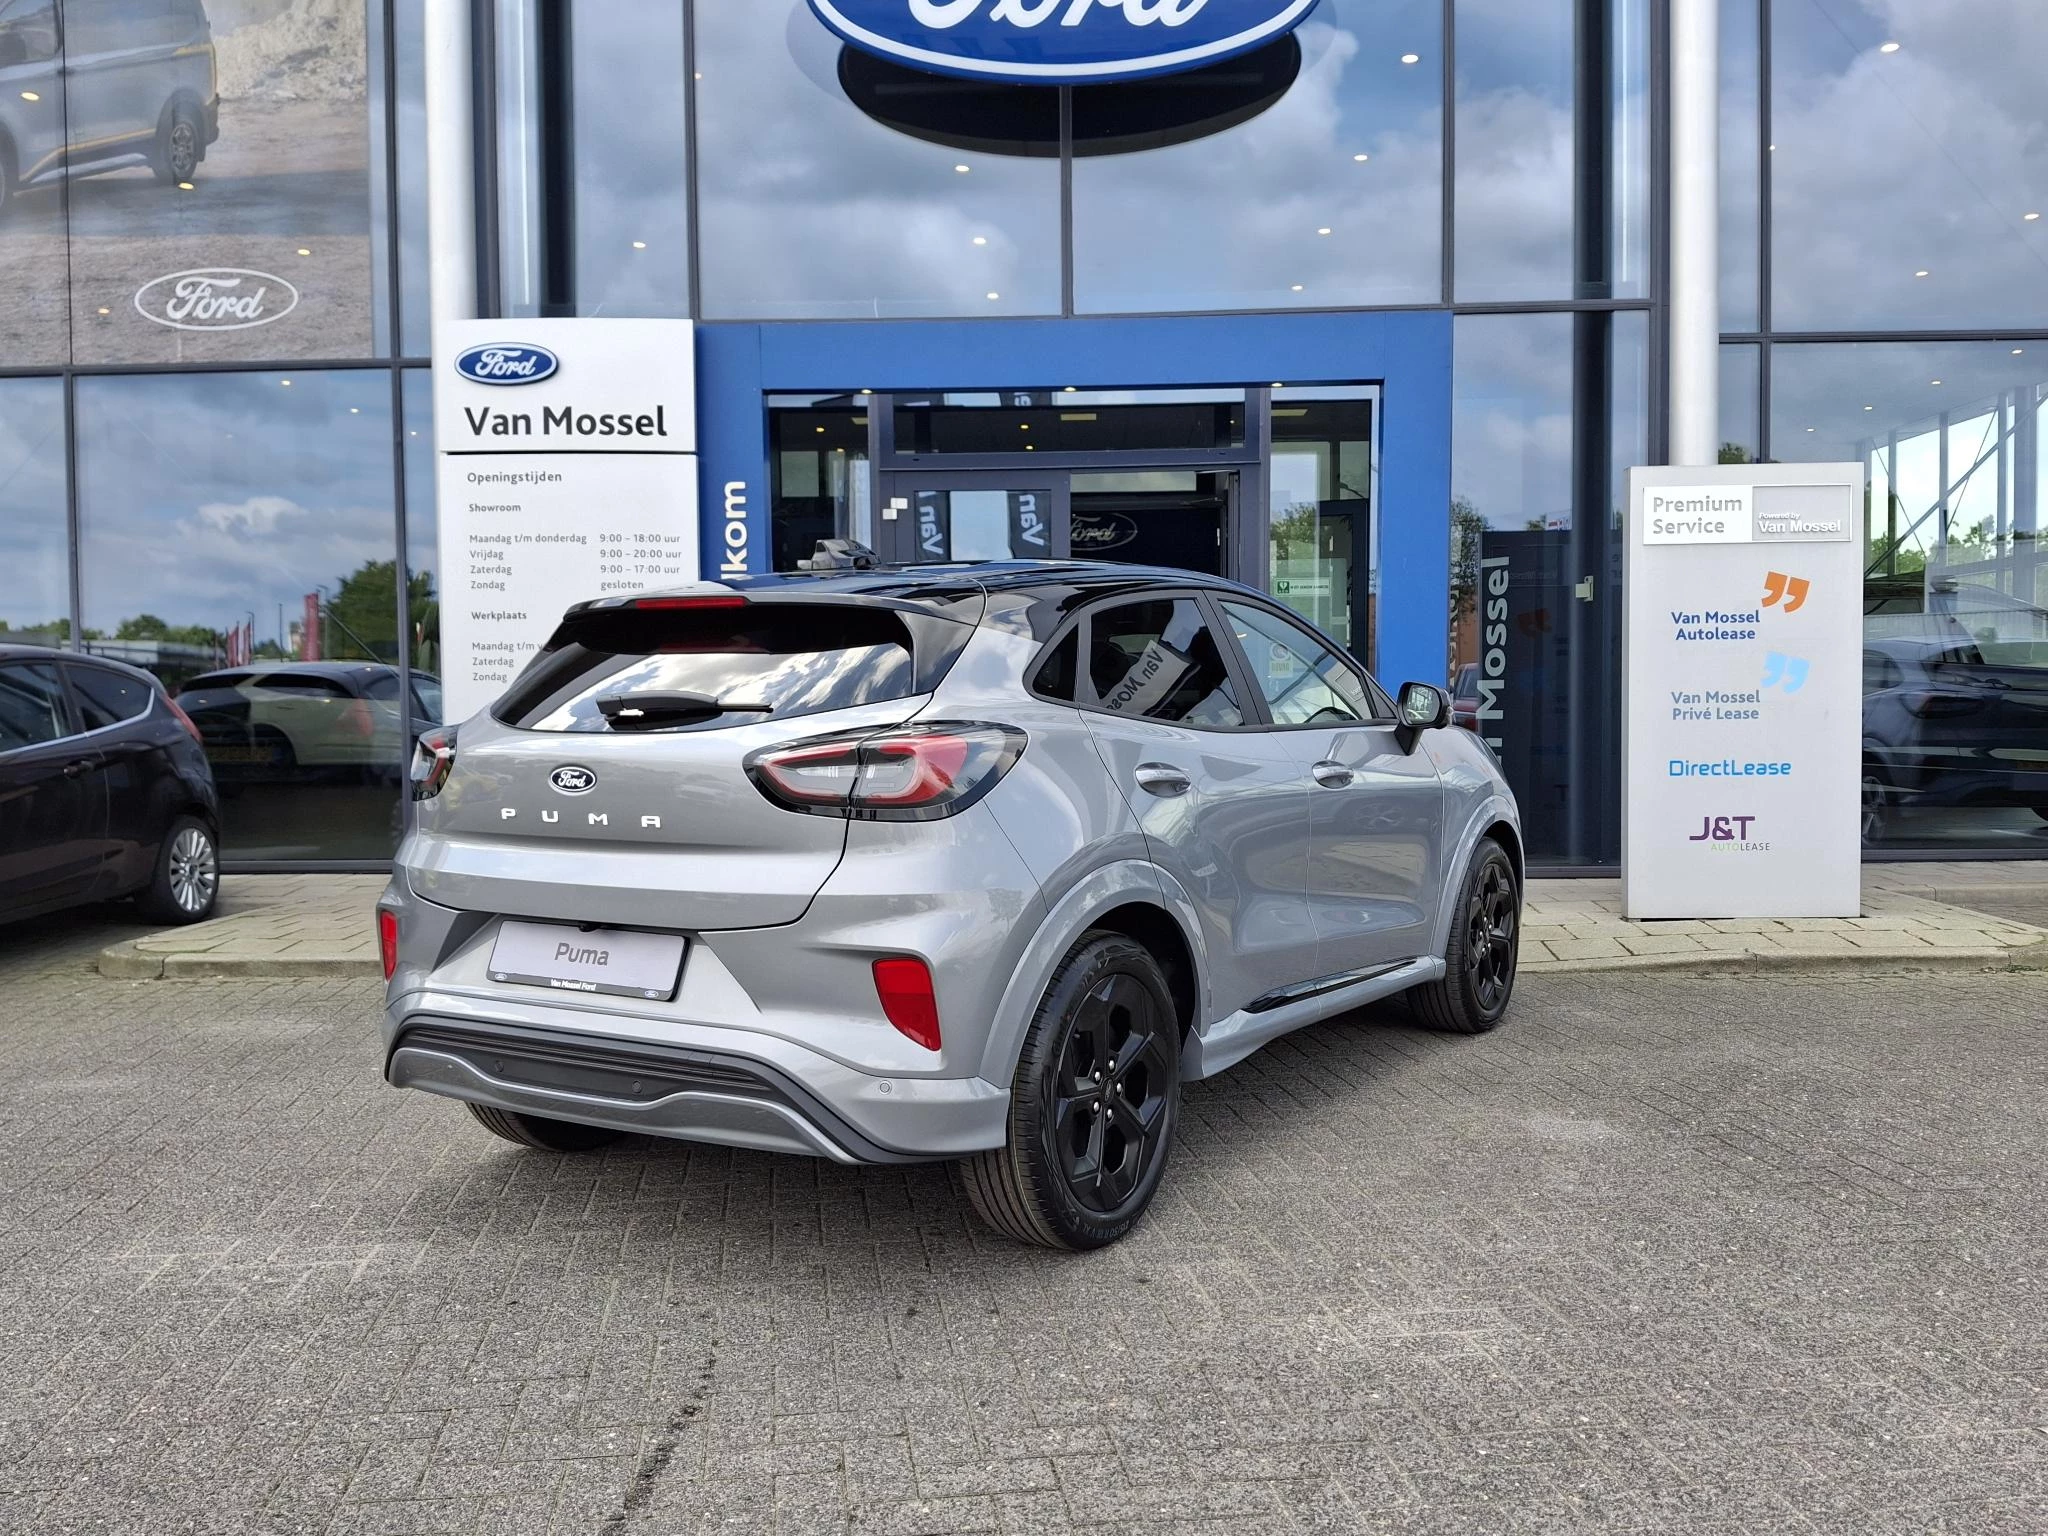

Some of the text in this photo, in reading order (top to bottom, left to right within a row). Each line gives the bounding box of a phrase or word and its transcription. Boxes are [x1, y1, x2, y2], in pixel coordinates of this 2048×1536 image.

[167, 278, 265, 321] Ford
[475, 349, 535, 376] Ford
[464, 405, 667, 436] Van Mossel
[467, 471, 562, 485] Openingstijden
[469, 504, 521, 512] Showroom
[1654, 495, 1742, 512] Premium
[1653, 517, 1724, 534] Service
[1757, 520, 1842, 534] Van Mossel
[470, 534, 512, 545] Maandag
[515, 534, 532, 542] t/m
[535, 534, 587, 545] donderdag
[600, 534, 622, 542] 9:00
[634, 534, 661, 542] 18:00
[469, 550, 503, 561] Vrijdag
[600, 549, 622, 558] 9:00
[634, 549, 662, 558] 20:00
[470, 565, 512, 575] Zaterdag
[600, 565, 622, 573] 9:00
[634, 565, 660, 573] 17:00
[471, 580, 643, 591] Zondag gesloten
[472, 611, 526, 622] Werkplaats
[1671, 610, 1760, 624] Van Mossel
[1475, 556, 1510, 720] Mossel
[1676, 627, 1755, 640] Autolease
[472, 642, 514, 652] Maandag
[517, 642, 534, 650] t/m
[473, 657, 514, 668] Zaterdag
[473, 672, 507, 683] Zondag
[1671, 690, 1760, 704] Van Mossel
[1673, 707, 1759, 720] Privé Lease
[1670, 760, 1791, 776] DirectLease
[558, 771, 586, 787] Ford
[1689, 816, 1755, 840] J&T
[1710, 840, 1772, 853] AUTOLEASE
[554, 942, 609, 966] Puma
[550, 978, 597, 992] Van Mossel Ford
